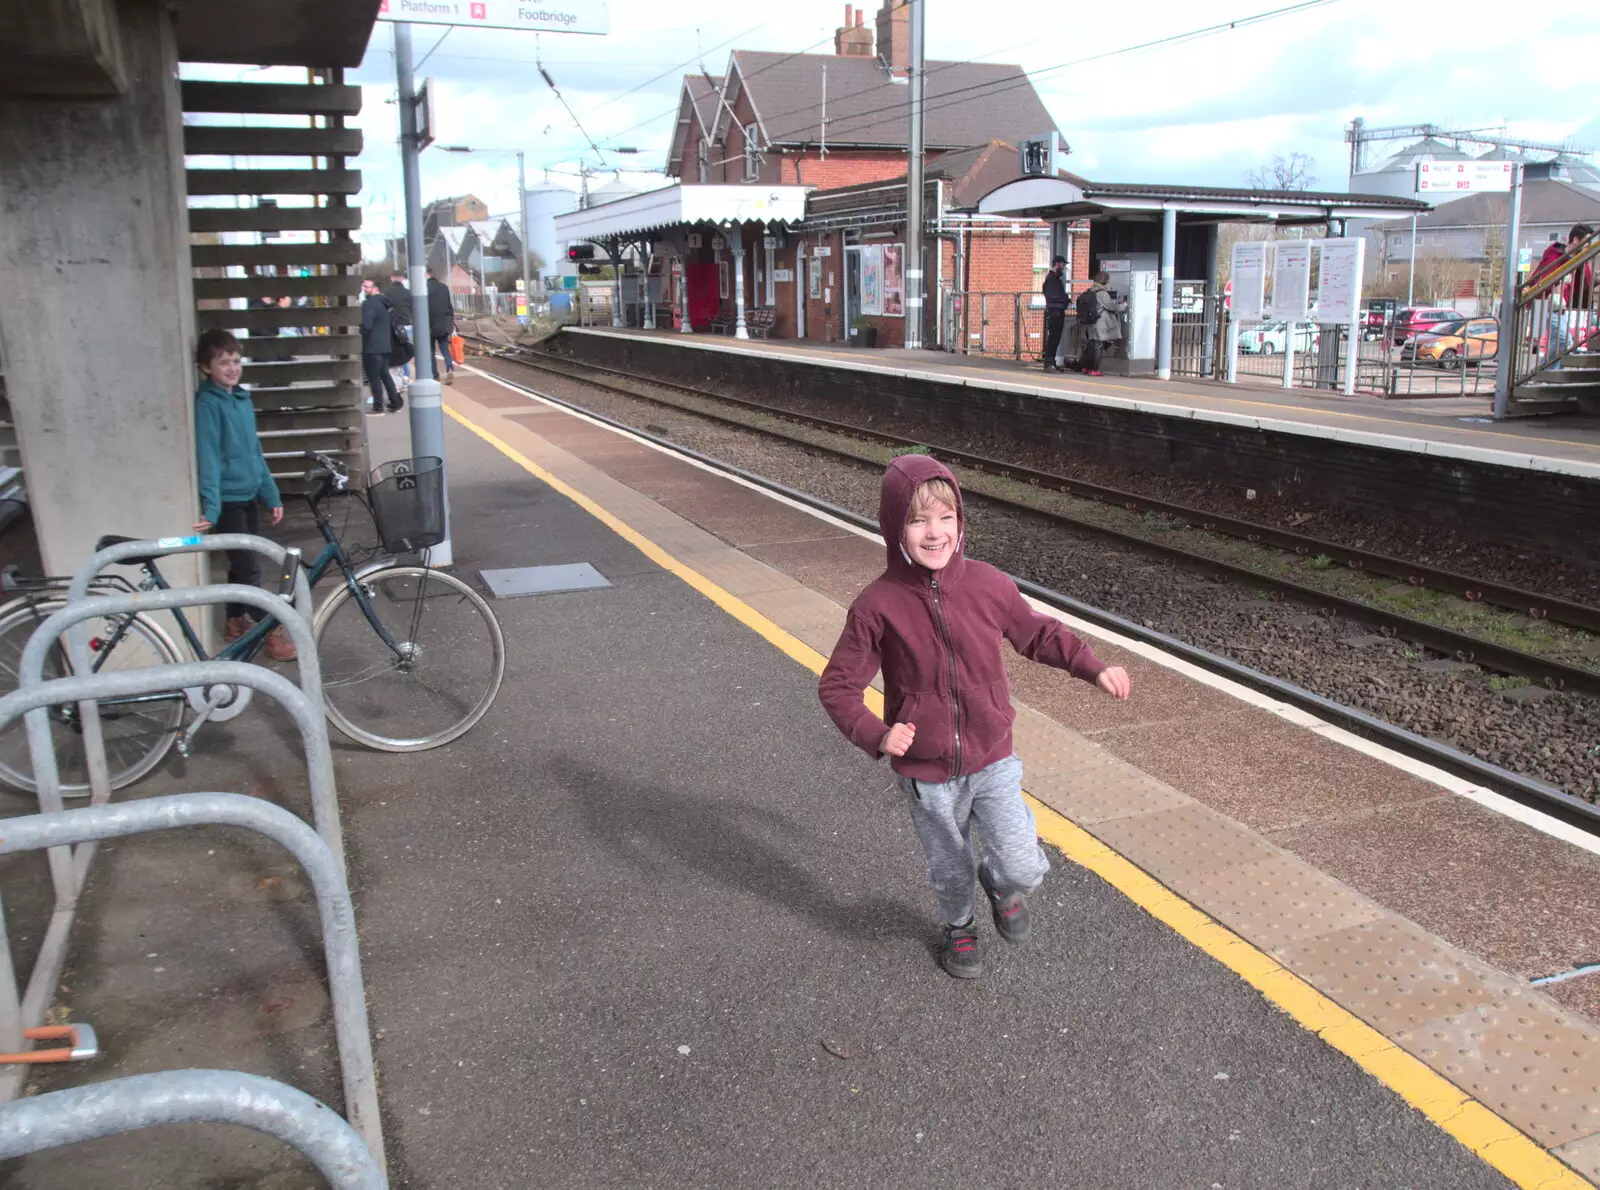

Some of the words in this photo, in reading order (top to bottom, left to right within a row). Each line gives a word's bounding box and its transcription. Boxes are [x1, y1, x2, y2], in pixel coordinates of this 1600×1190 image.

[400, 0, 450, 14] Platform
[454, 4, 459, 15] 1
[518, 8, 577, 26] Footbridge
